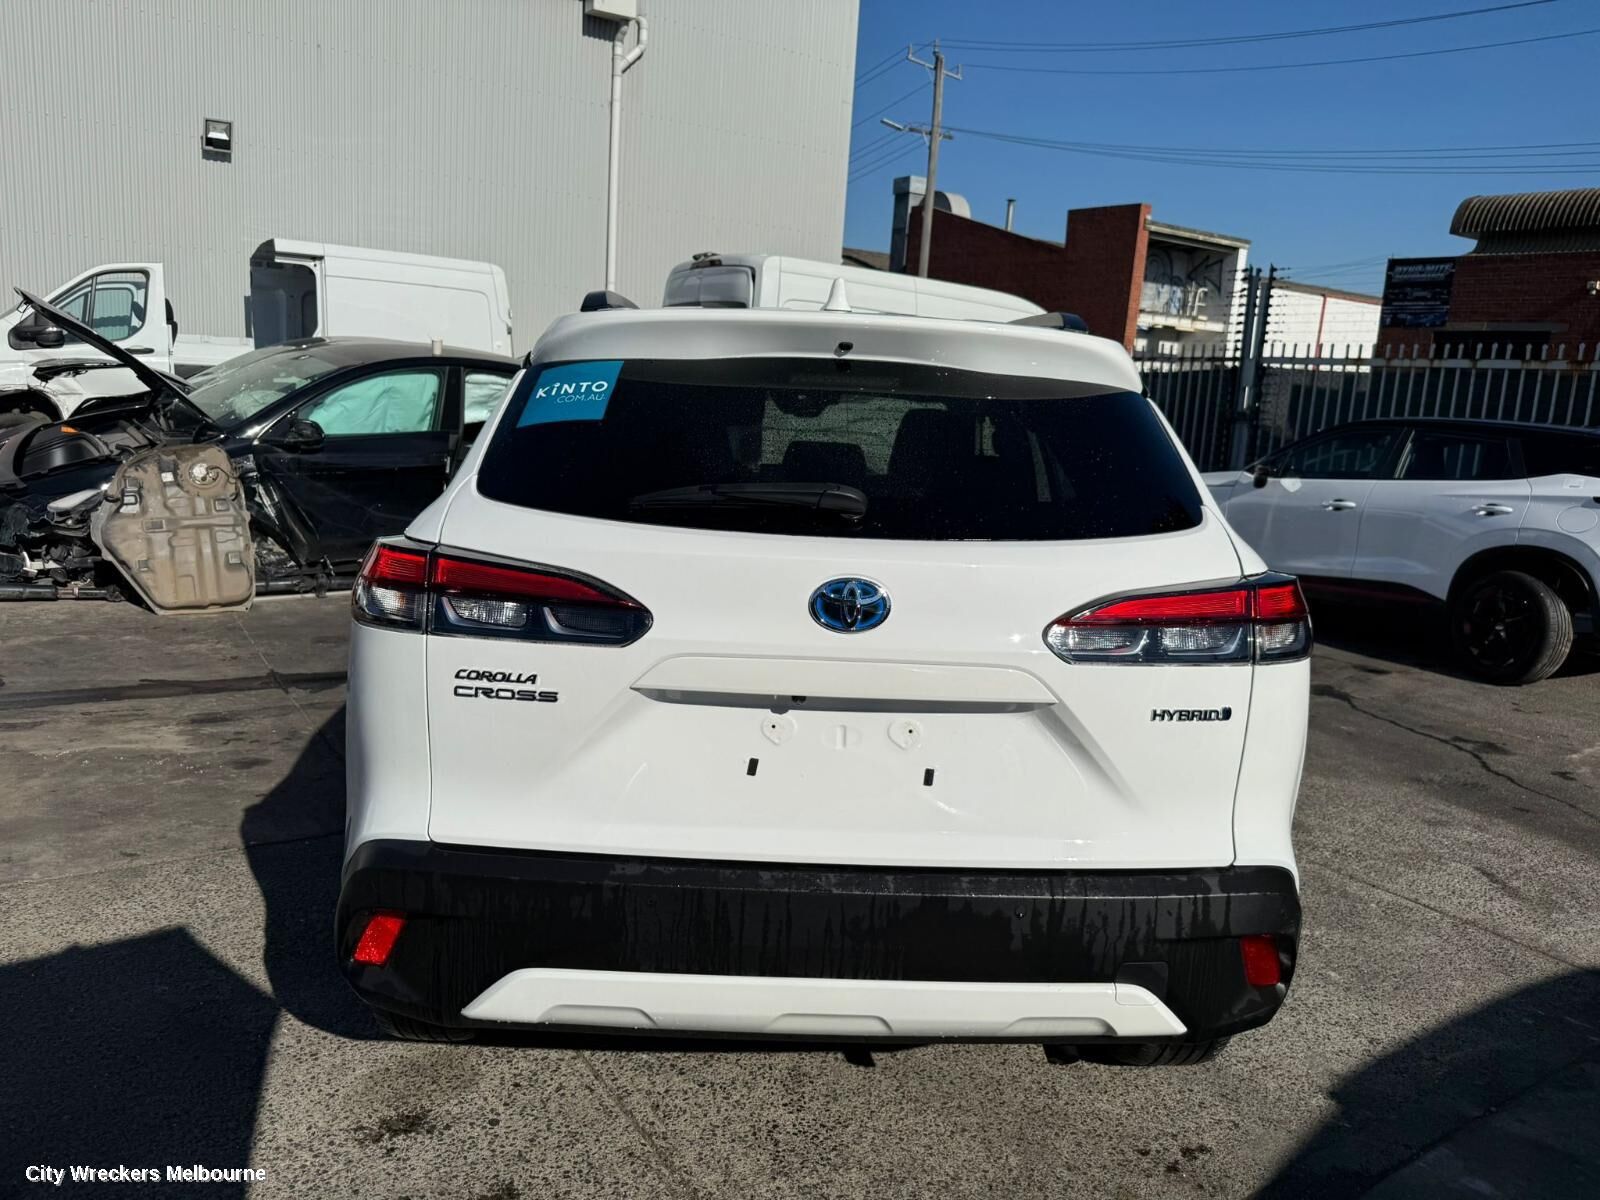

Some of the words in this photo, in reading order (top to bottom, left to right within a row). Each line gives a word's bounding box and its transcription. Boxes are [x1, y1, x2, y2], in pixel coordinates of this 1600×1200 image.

[454, 669, 538, 685] COROLLA
[453, 685, 559, 703] CROSS
[1150, 708, 1221, 722] HYBRID
